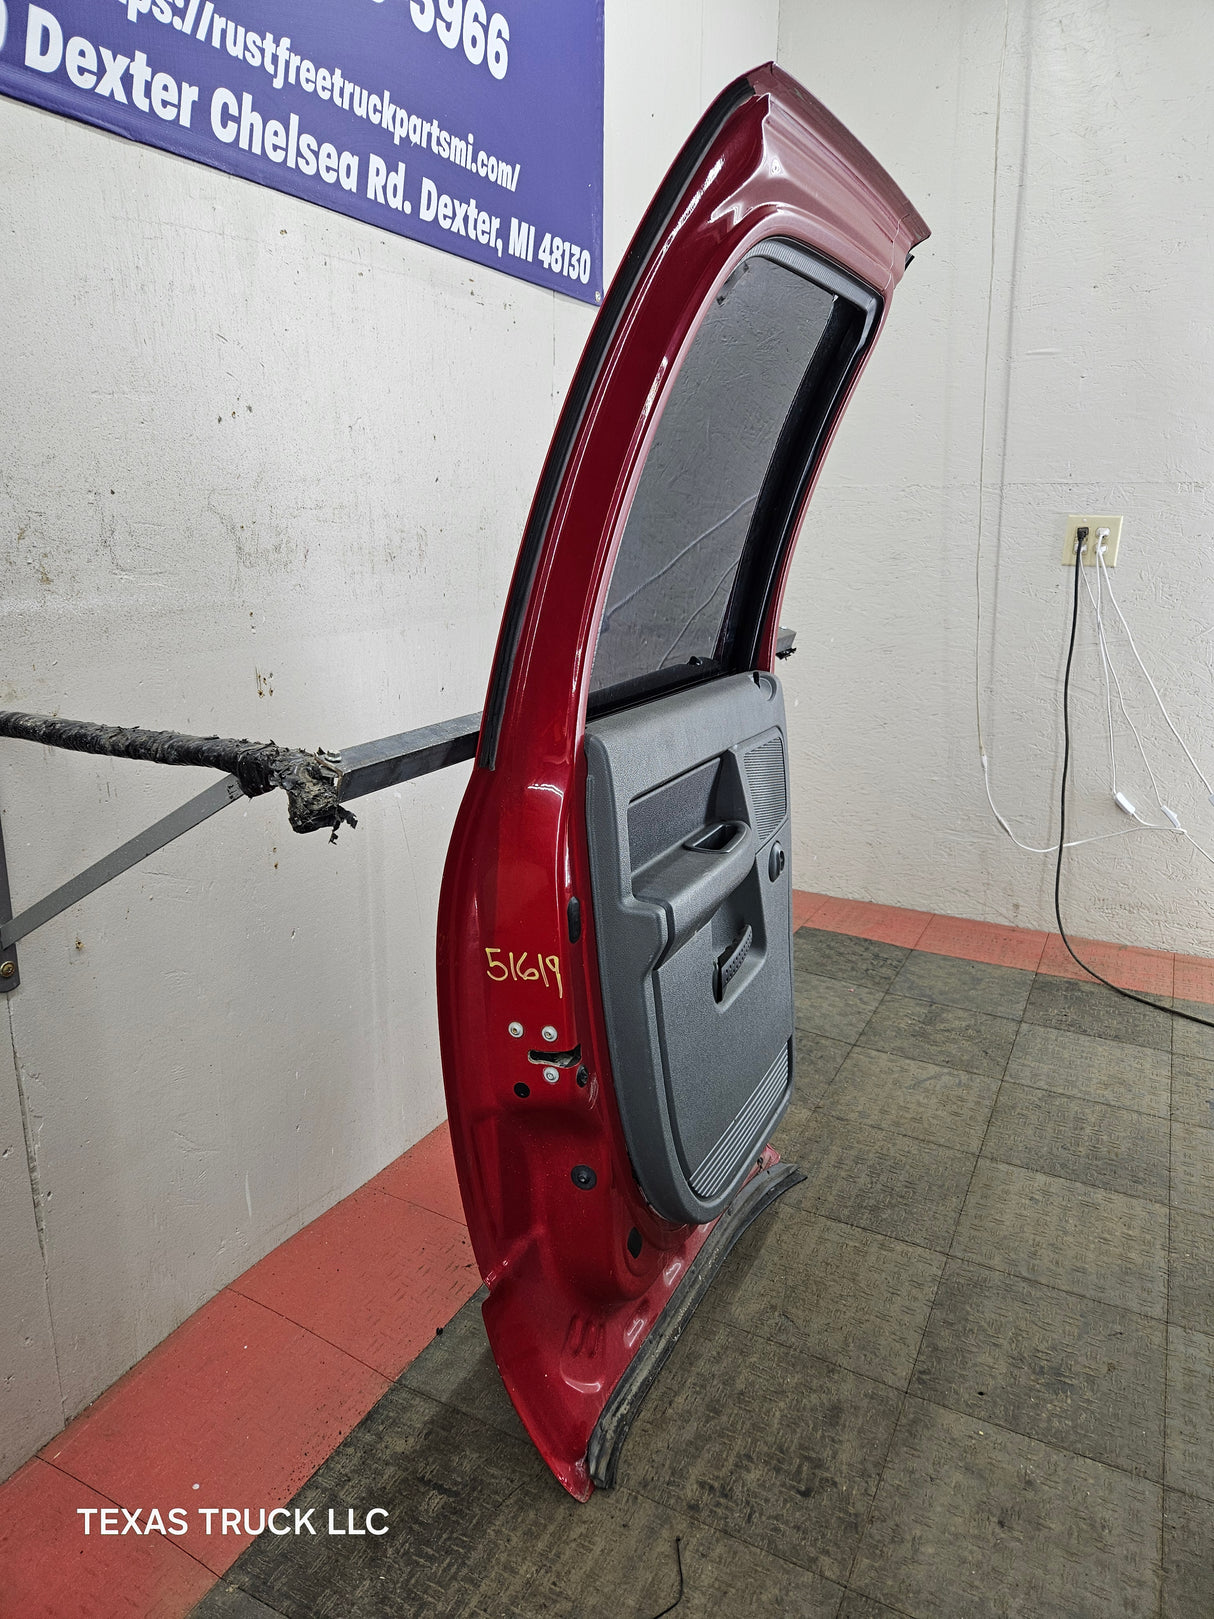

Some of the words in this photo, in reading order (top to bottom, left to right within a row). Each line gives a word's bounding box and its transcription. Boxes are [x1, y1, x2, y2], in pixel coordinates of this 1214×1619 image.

[25, 3, 199, 128] Dexter
[210, 87, 359, 193] Chelsea
[367, 153, 412, 214] Rd.
[419, 177, 502, 257] Dexter,
[508, 217, 536, 262] MI
[538, 232, 591, 284] 48130
[119, 0, 521, 192] s://rustfreetruckpartsmi.com/
[485, 947, 563, 999] 51619
